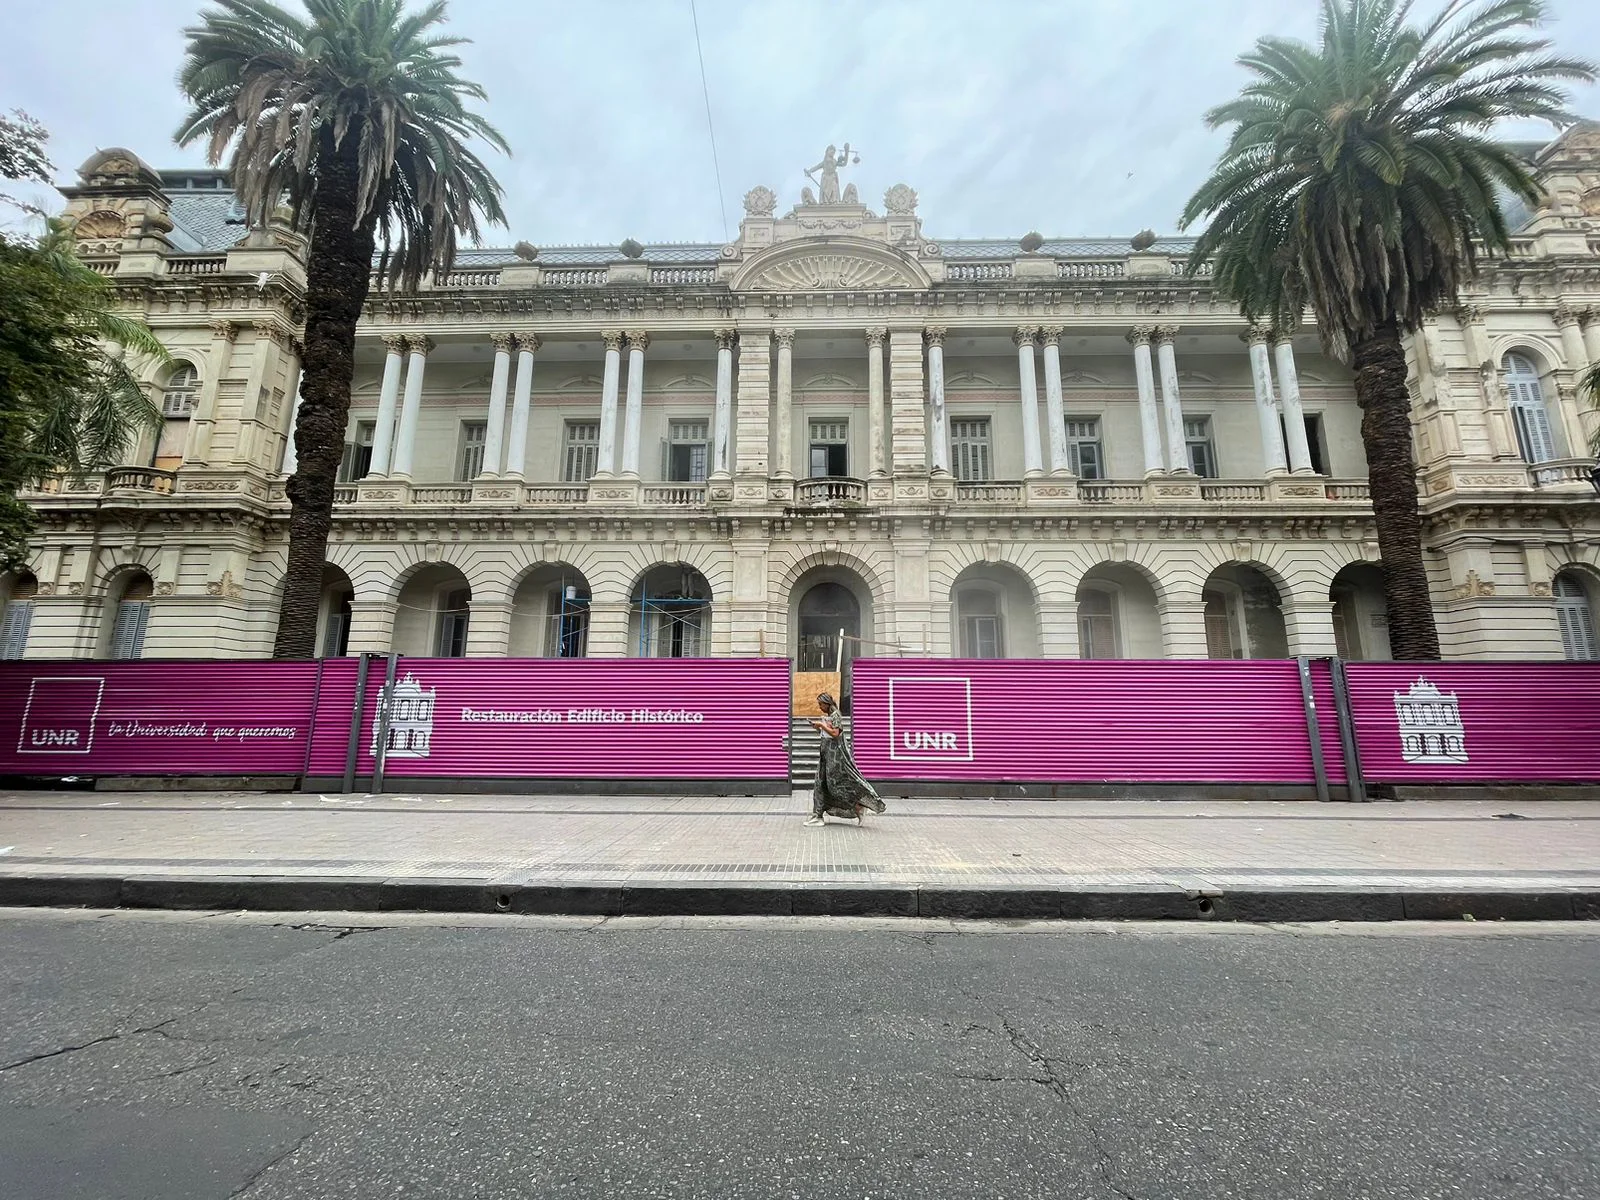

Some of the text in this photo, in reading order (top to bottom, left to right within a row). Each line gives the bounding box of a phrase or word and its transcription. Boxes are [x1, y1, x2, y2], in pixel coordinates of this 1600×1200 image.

[460, 707, 704, 724] Restauración Edificio Histórico
[31, 729, 80, 745] UNR
[212, 726, 235, 742] que
[237, 726, 297, 742] queremos
[903, 731, 959, 750] UNR
